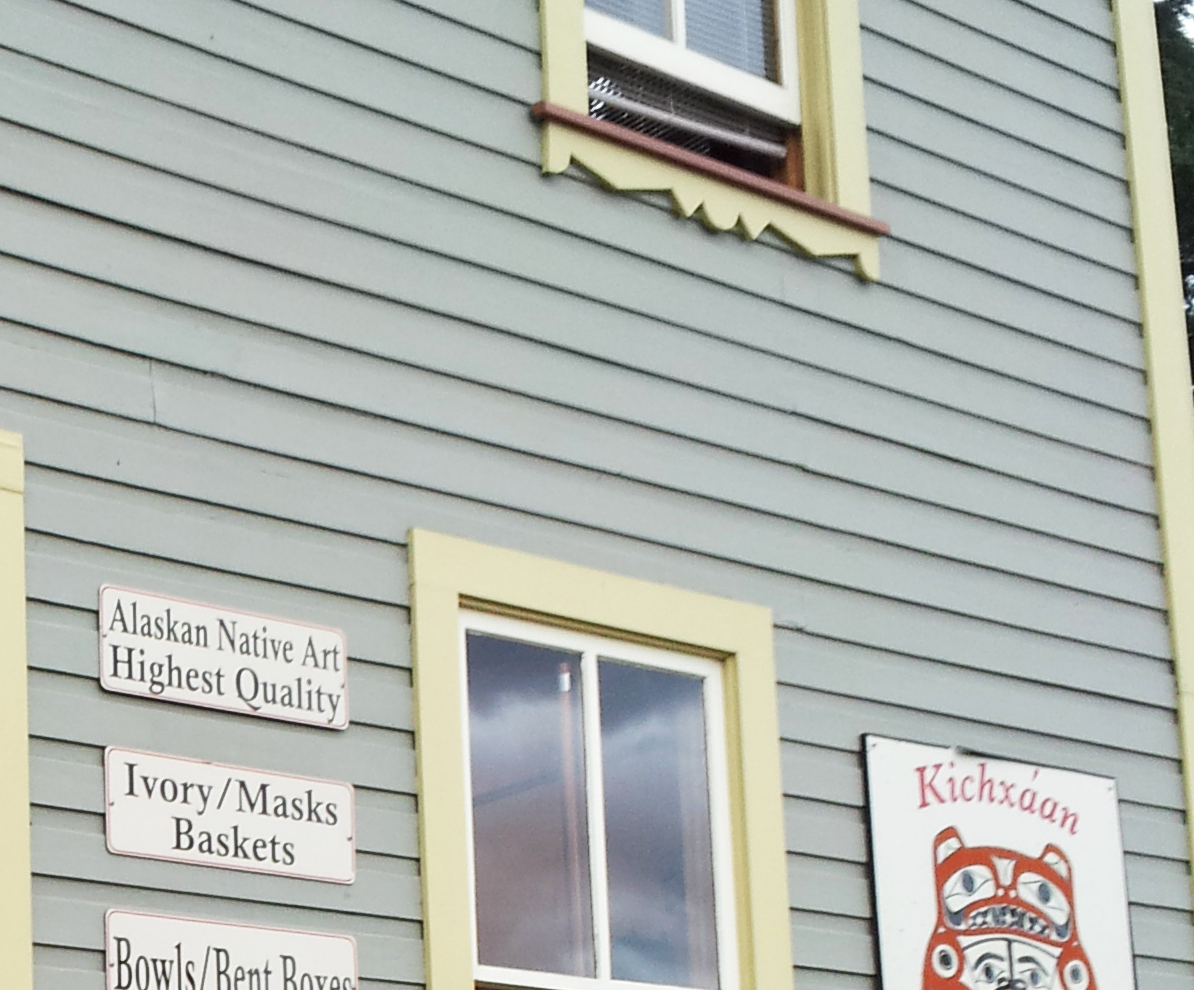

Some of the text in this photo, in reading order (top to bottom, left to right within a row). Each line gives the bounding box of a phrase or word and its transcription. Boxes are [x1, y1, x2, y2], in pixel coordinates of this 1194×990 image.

[108, 598, 341, 672] Alaskan Native Art
[109, 644, 341, 723] Highest Quality
[124, 762, 338, 826] Ivory/Masks
[915, 761, 1080, 835] Kichxáan
[171, 816, 296, 866] Baskets
